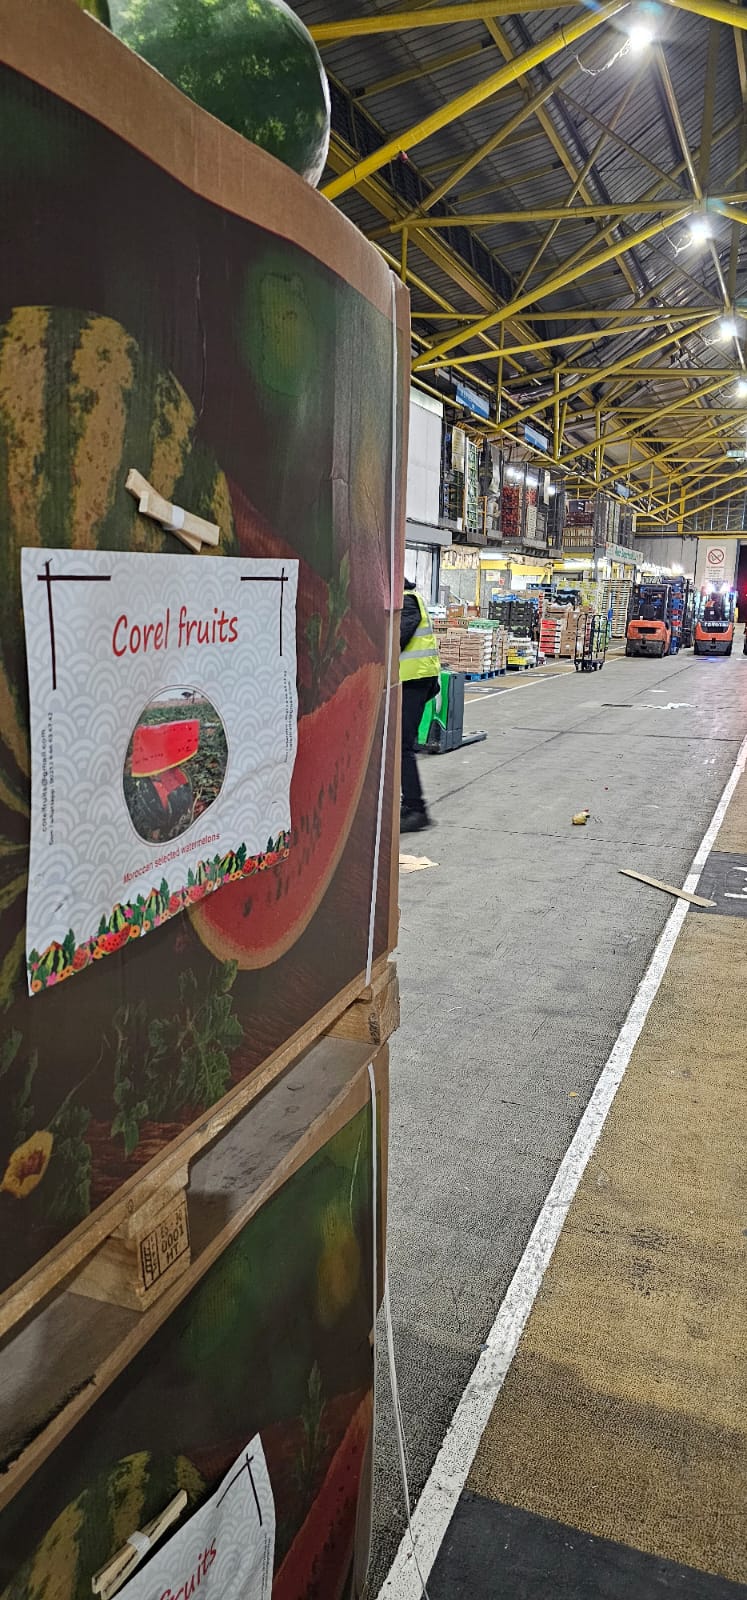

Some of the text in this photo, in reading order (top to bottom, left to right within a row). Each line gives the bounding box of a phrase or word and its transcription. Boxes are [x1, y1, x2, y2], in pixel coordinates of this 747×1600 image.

[112, 605, 238, 657] Corel fruits
[123, 832, 221, 885] Moroccan selected watermelons
[161, 1223, 184, 1253] 0001
[166, 1242, 179, 1264] HT
